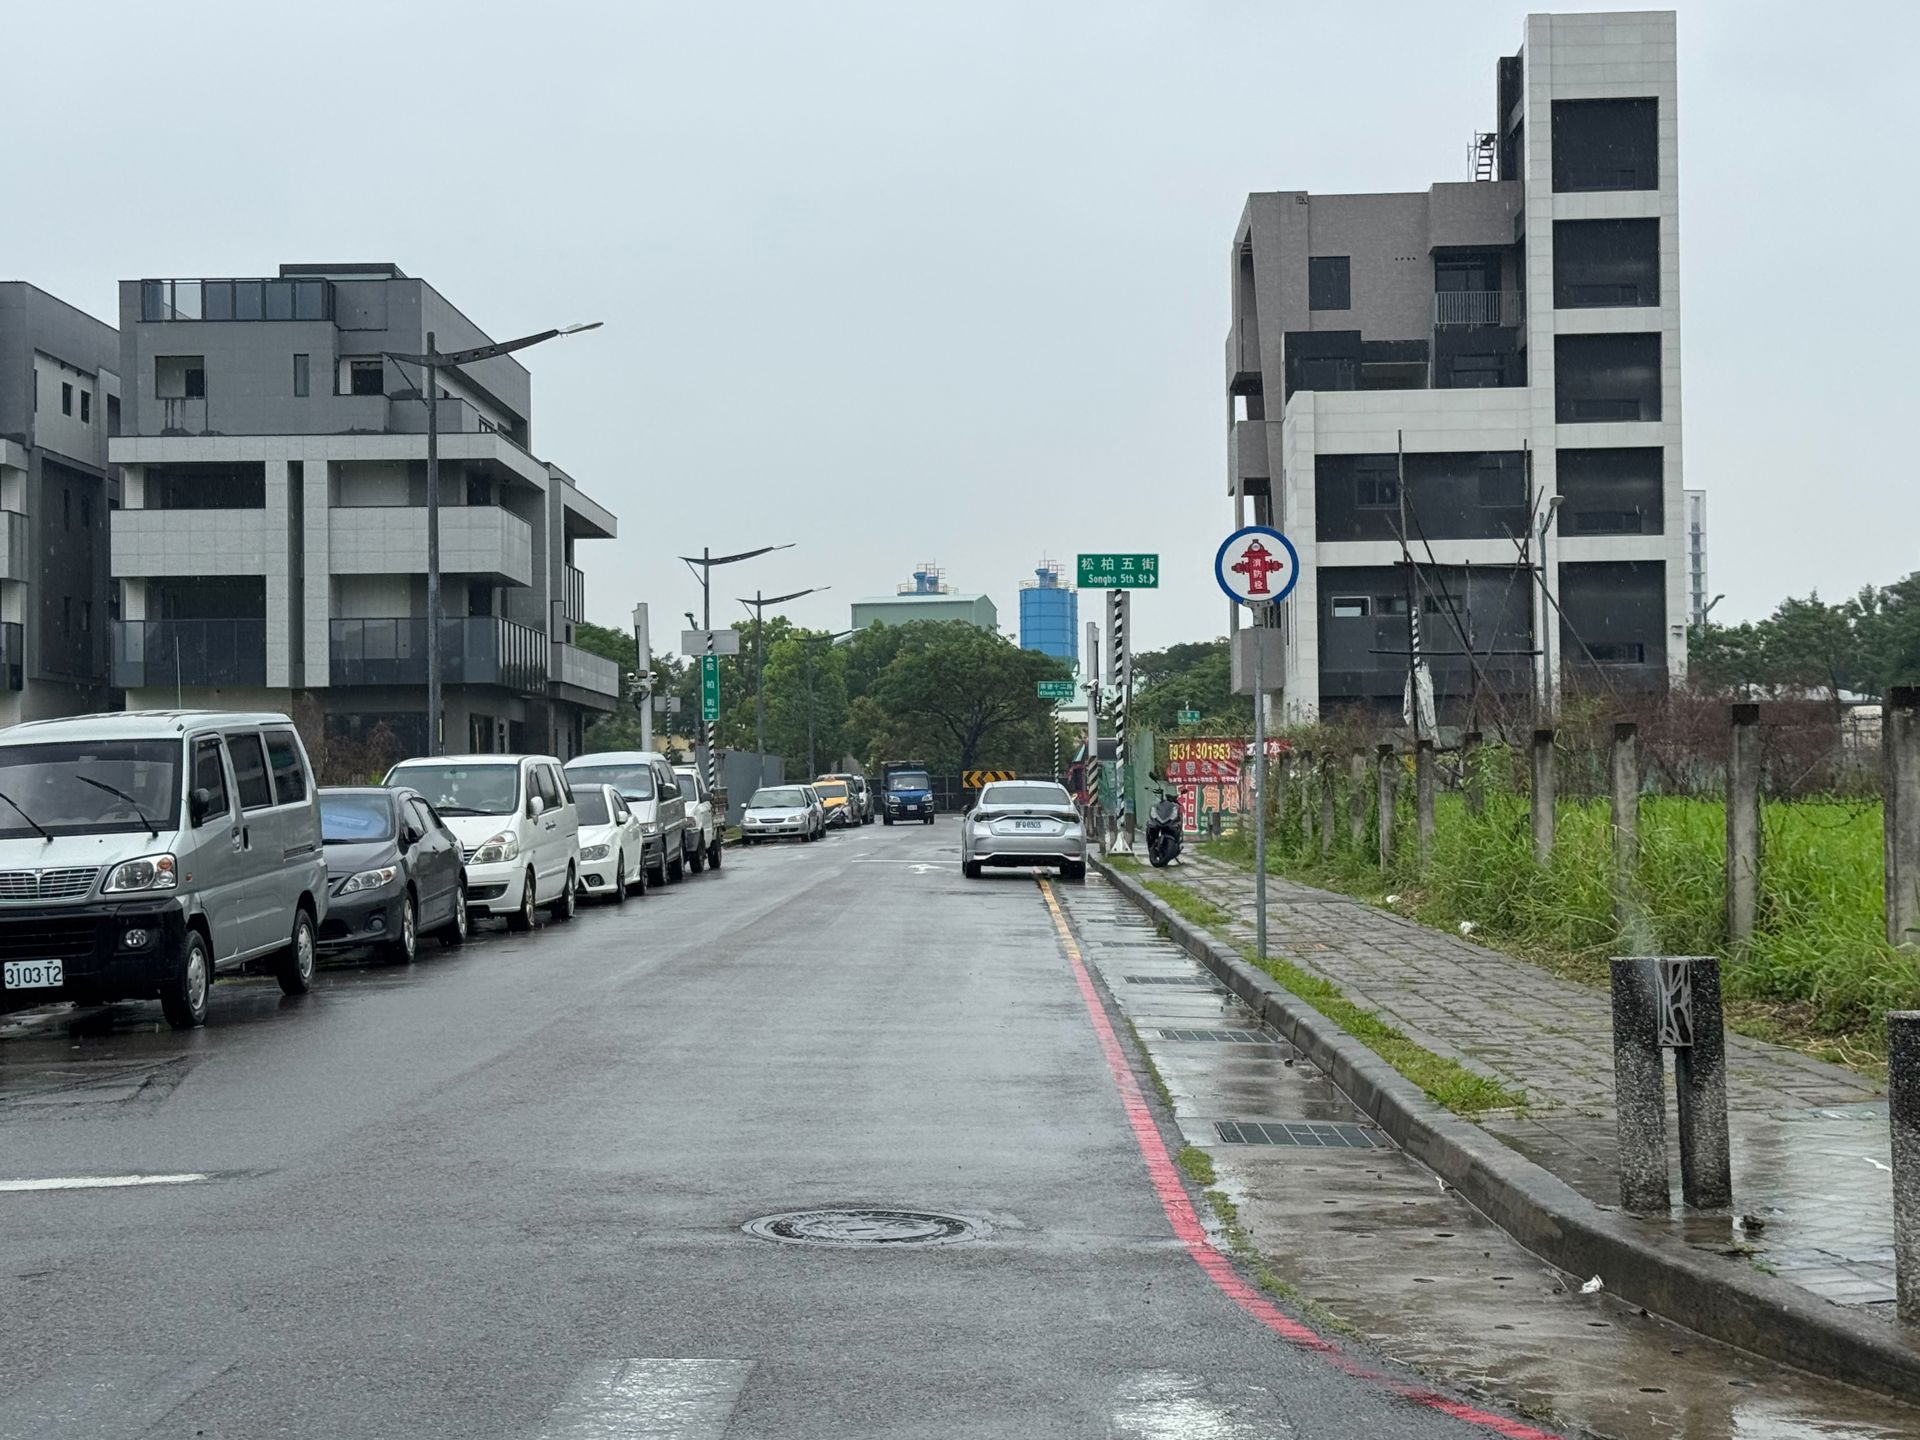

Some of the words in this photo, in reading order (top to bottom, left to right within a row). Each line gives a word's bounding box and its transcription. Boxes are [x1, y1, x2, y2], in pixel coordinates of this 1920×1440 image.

[1081, 557, 1155, 571] 松柏五街
[1088, 574, 1117, 586] Songbo
[1120, 574, 1134, 584] 5th
[1252, 558, 1263, 590] 消防栓
